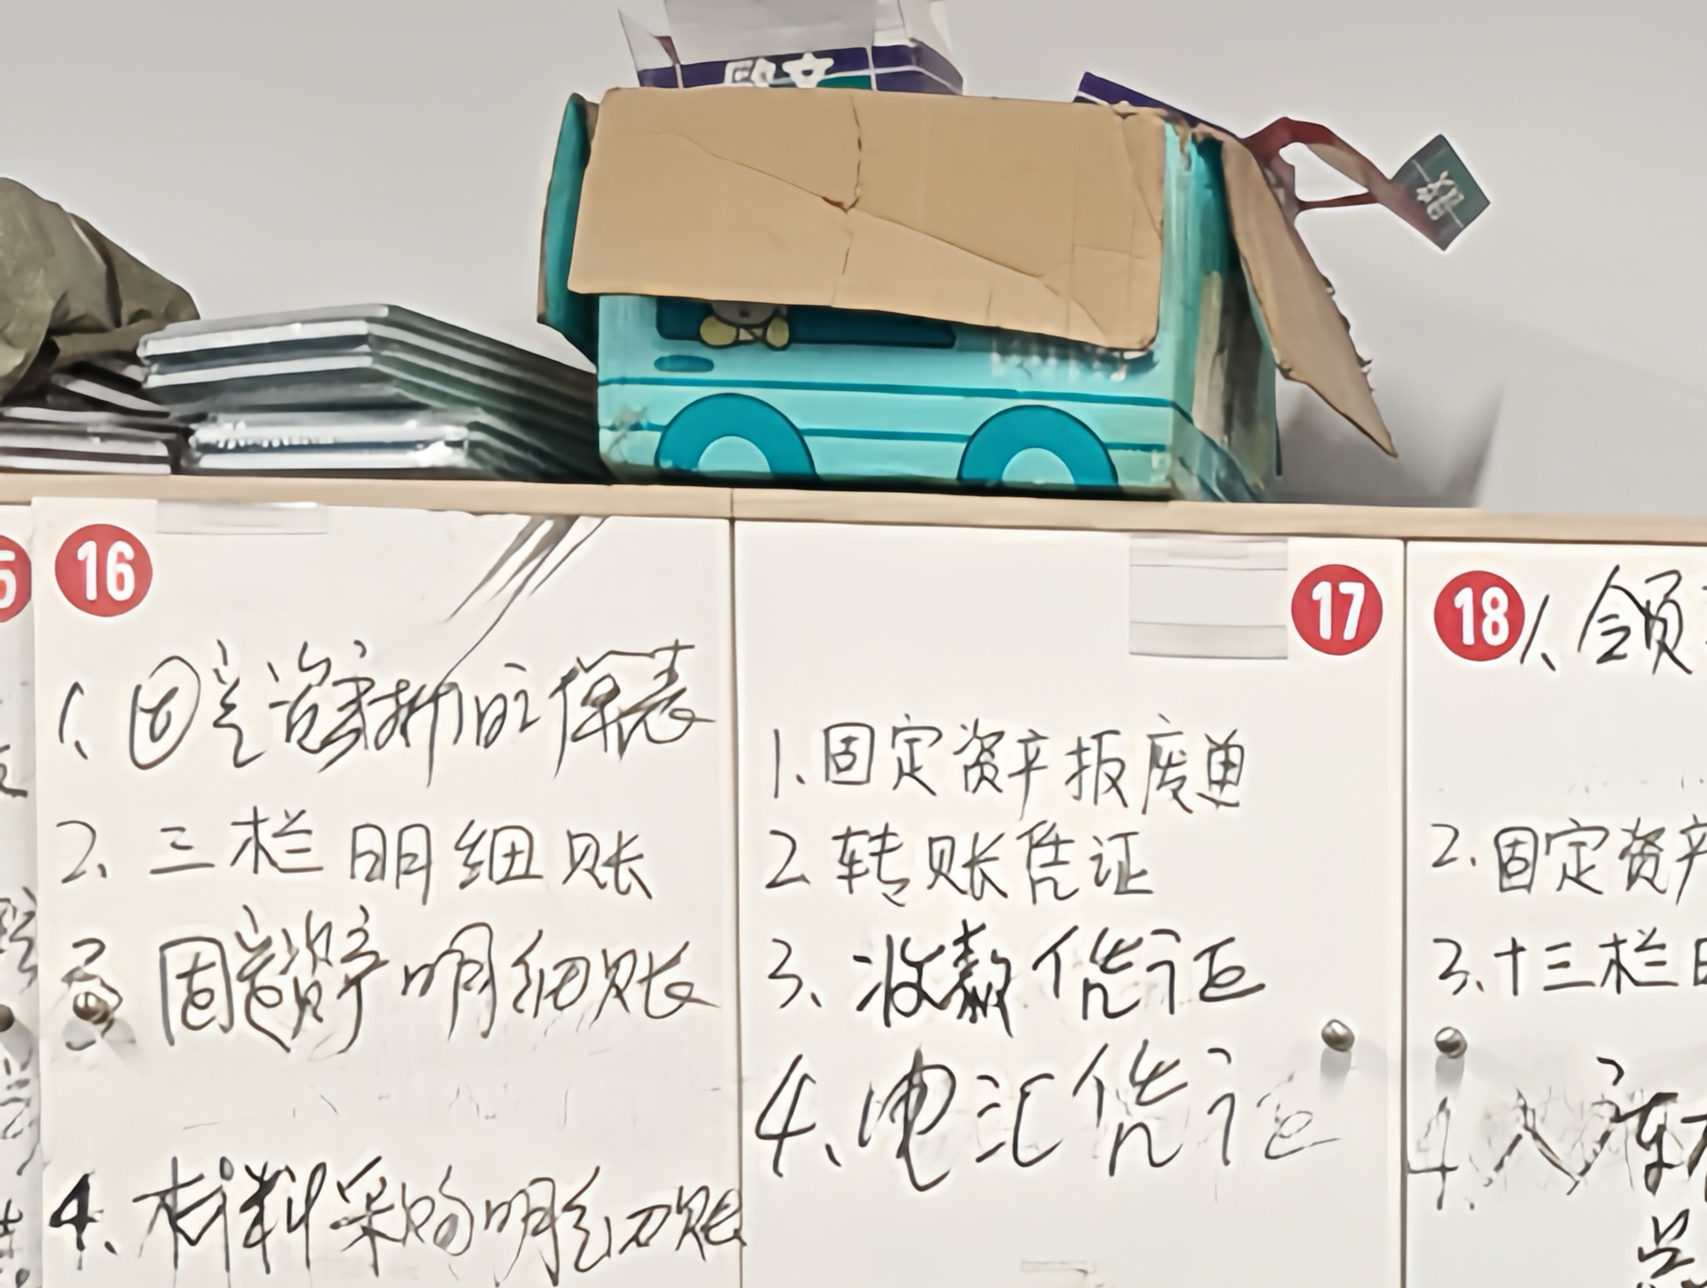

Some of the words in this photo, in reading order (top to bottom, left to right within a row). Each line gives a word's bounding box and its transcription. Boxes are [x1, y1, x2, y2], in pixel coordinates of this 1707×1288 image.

[76, 540, 136, 601] 16
[1311, 581, 1365, 641] 17
[1453, 586, 1511, 647] 18
